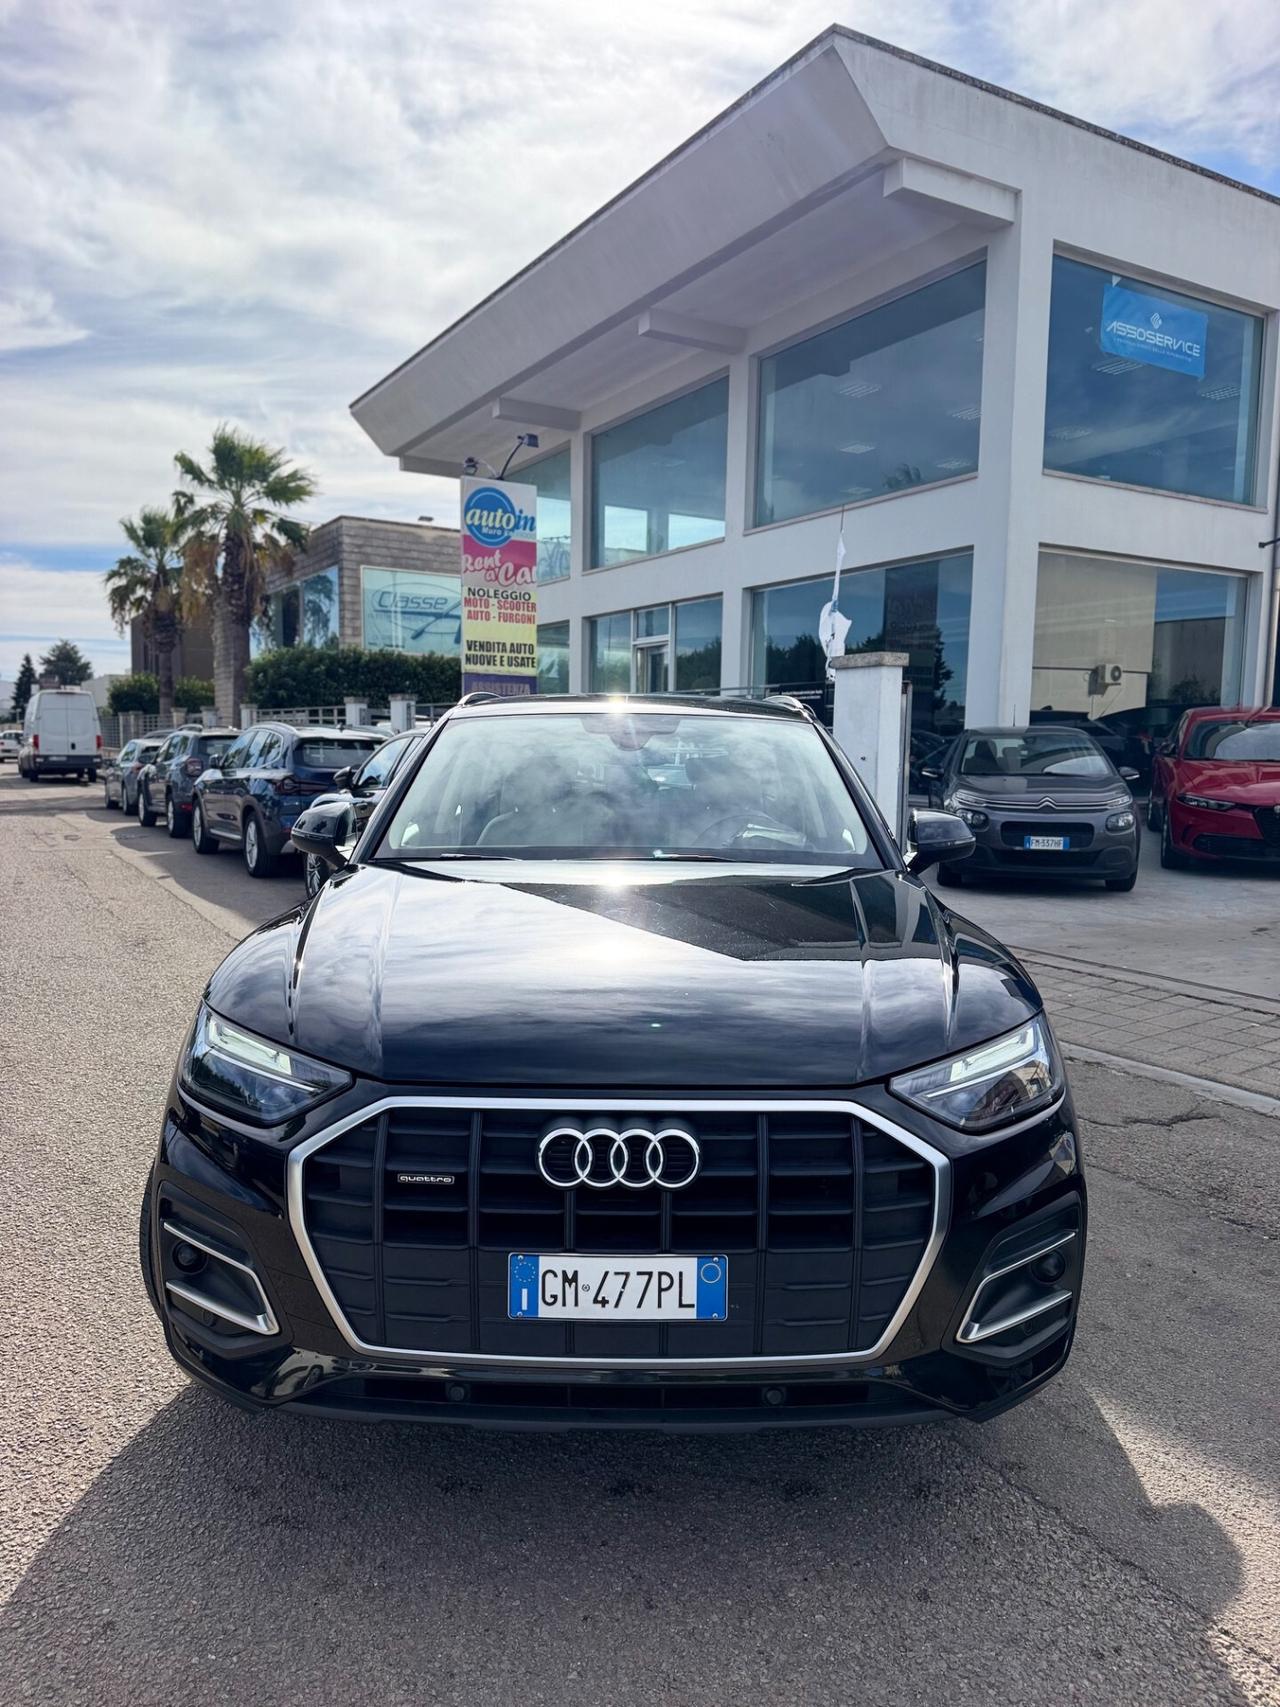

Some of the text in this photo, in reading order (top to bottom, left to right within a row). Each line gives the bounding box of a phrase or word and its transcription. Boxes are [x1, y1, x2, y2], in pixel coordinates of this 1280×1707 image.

[1106, 320, 1201, 357] ASSOSERVICE
[462, 549, 502, 572] Rent
[378, 591, 448, 610] Classe
[467, 587, 531, 602] NOLEGGIO
[464, 597, 490, 609] MOTO
[497, 600, 536, 612] SCOOTER
[467, 609, 490, 621] AUTO
[498, 612, 536, 624] FURGONI
[466, 640, 534, 655] VENDITA AUTO
[465, 653, 536, 668] NUOVE E USATE
[399, 1175, 452, 1183] quattro
[541, 1269, 579, 1307] GM
[592, 1271, 696, 1308] 477PL
